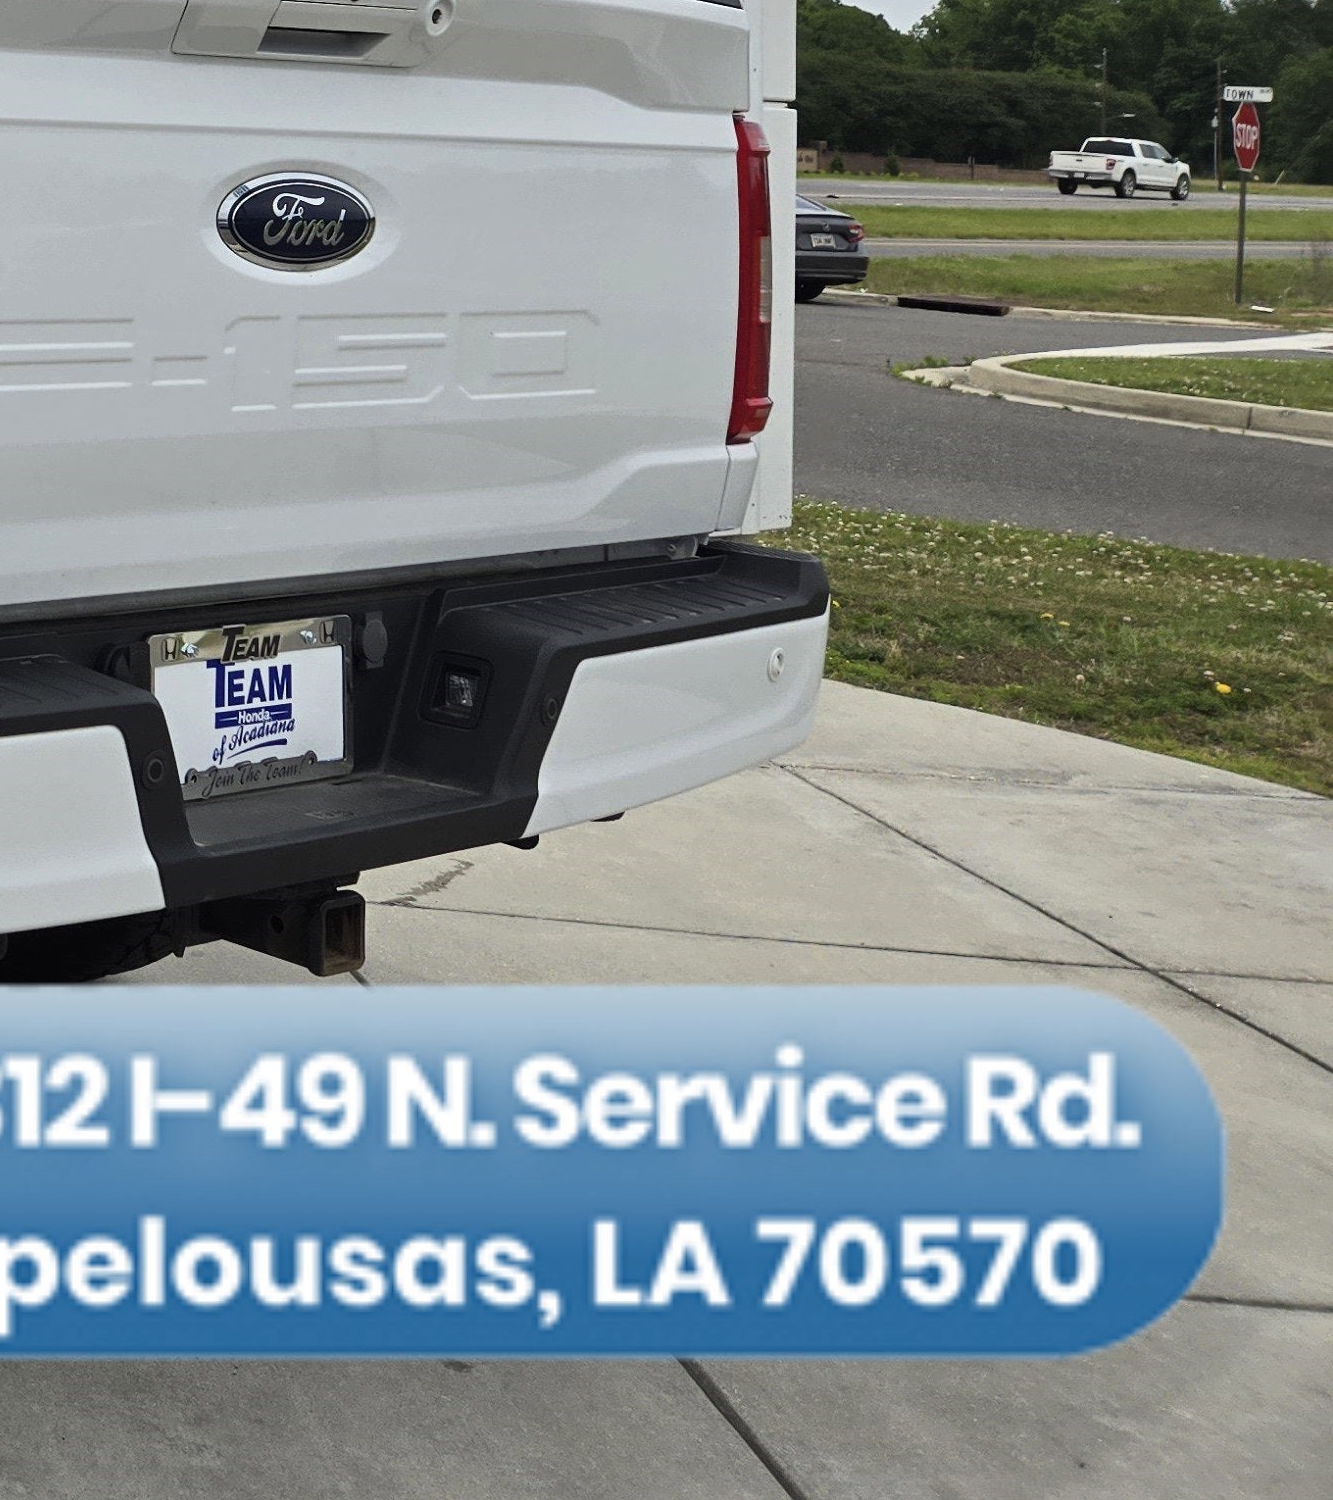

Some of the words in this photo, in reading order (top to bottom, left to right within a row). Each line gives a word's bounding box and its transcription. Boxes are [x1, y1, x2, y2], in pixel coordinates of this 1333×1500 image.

[1236, 123, 1258, 149] STOP
[263, 192, 347, 247] Ford
[220, 624, 281, 664] TEAM
[206, 659, 292, 708] TEAM
[229, 718, 295, 751] Acadiana
[237, 709, 271, 725] Honda
[202, 767, 235, 799] Join
[239, 762, 260, 783] The
[264, 758, 306, 781] Team!
